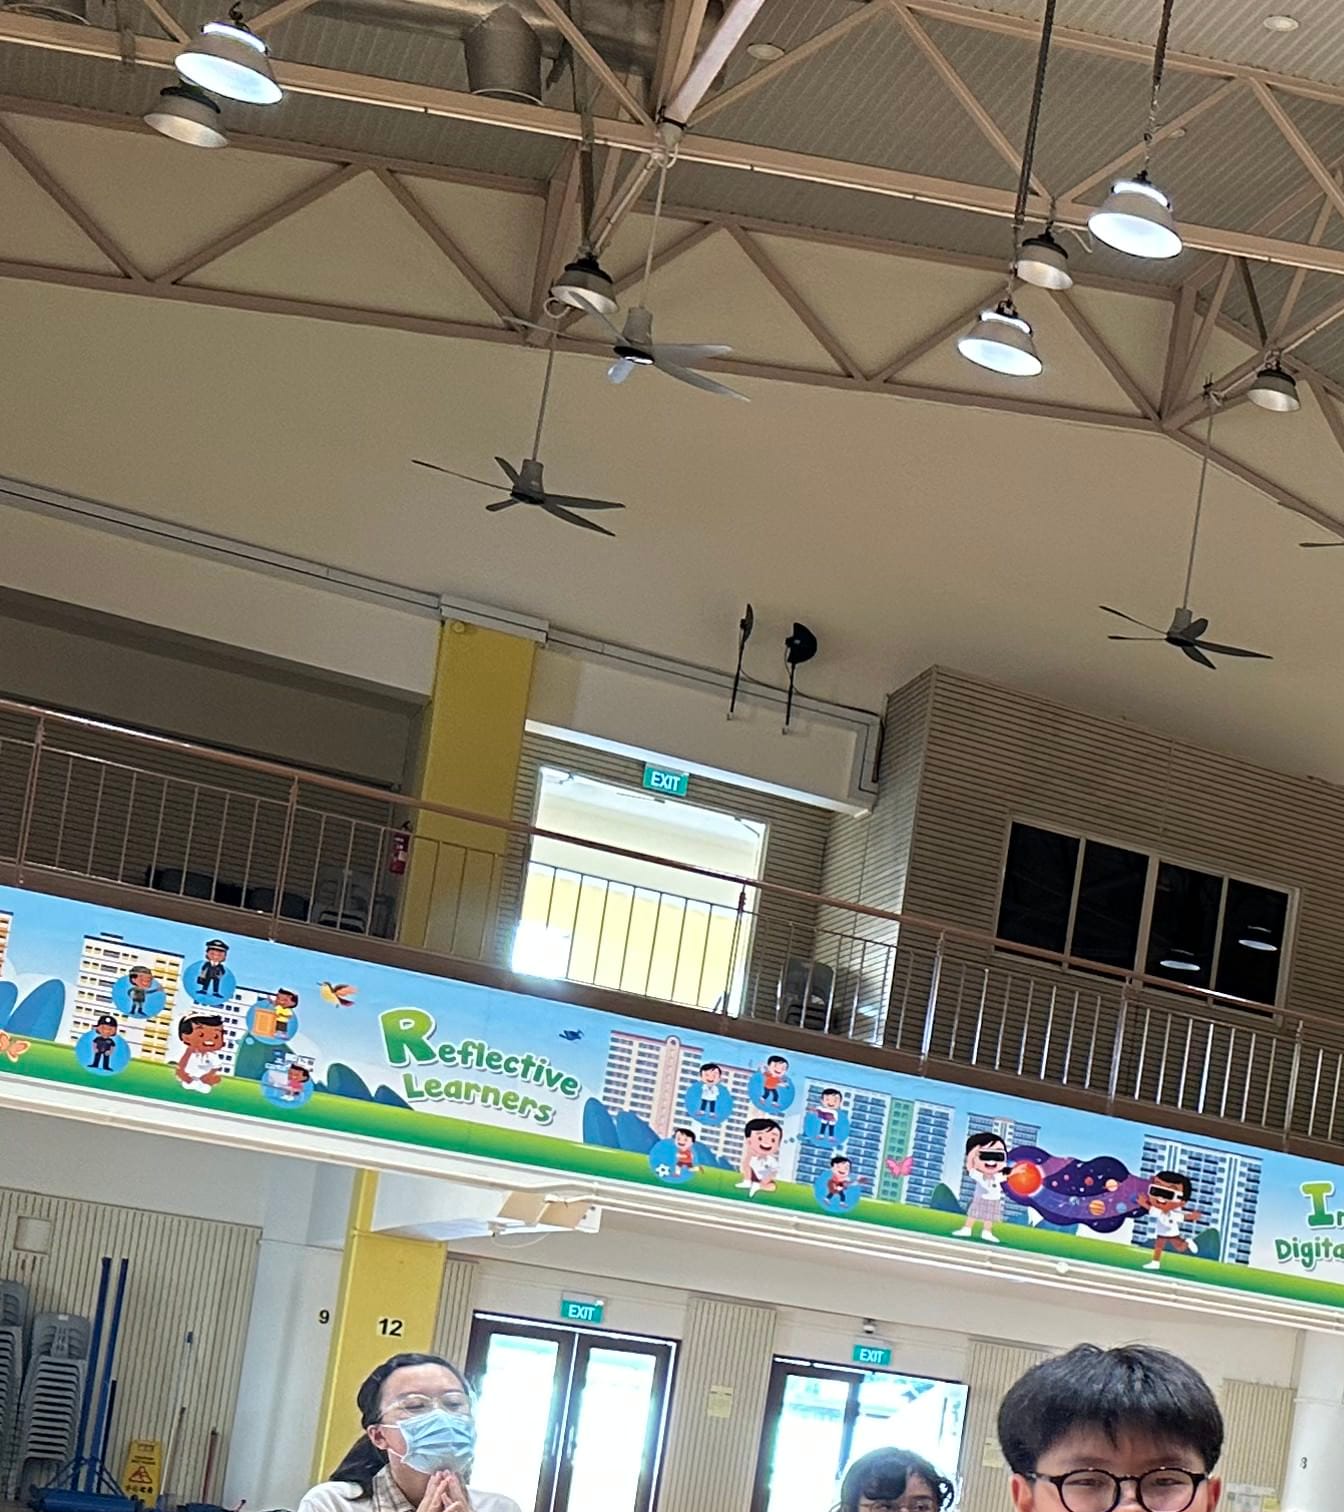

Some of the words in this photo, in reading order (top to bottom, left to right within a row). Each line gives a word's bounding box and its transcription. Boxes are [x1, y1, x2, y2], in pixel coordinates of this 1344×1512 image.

[650, 771, 680, 791] EXIT
[380, 1008, 579, 1095] Reflective
[403, 1073, 552, 1122] Learners
[319, 1310, 330, 1324] 9
[568, 1304, 595, 1320] EXIT
[378, 1318, 403, 1336] 12
[860, 1349, 884, 1363] EXIT
